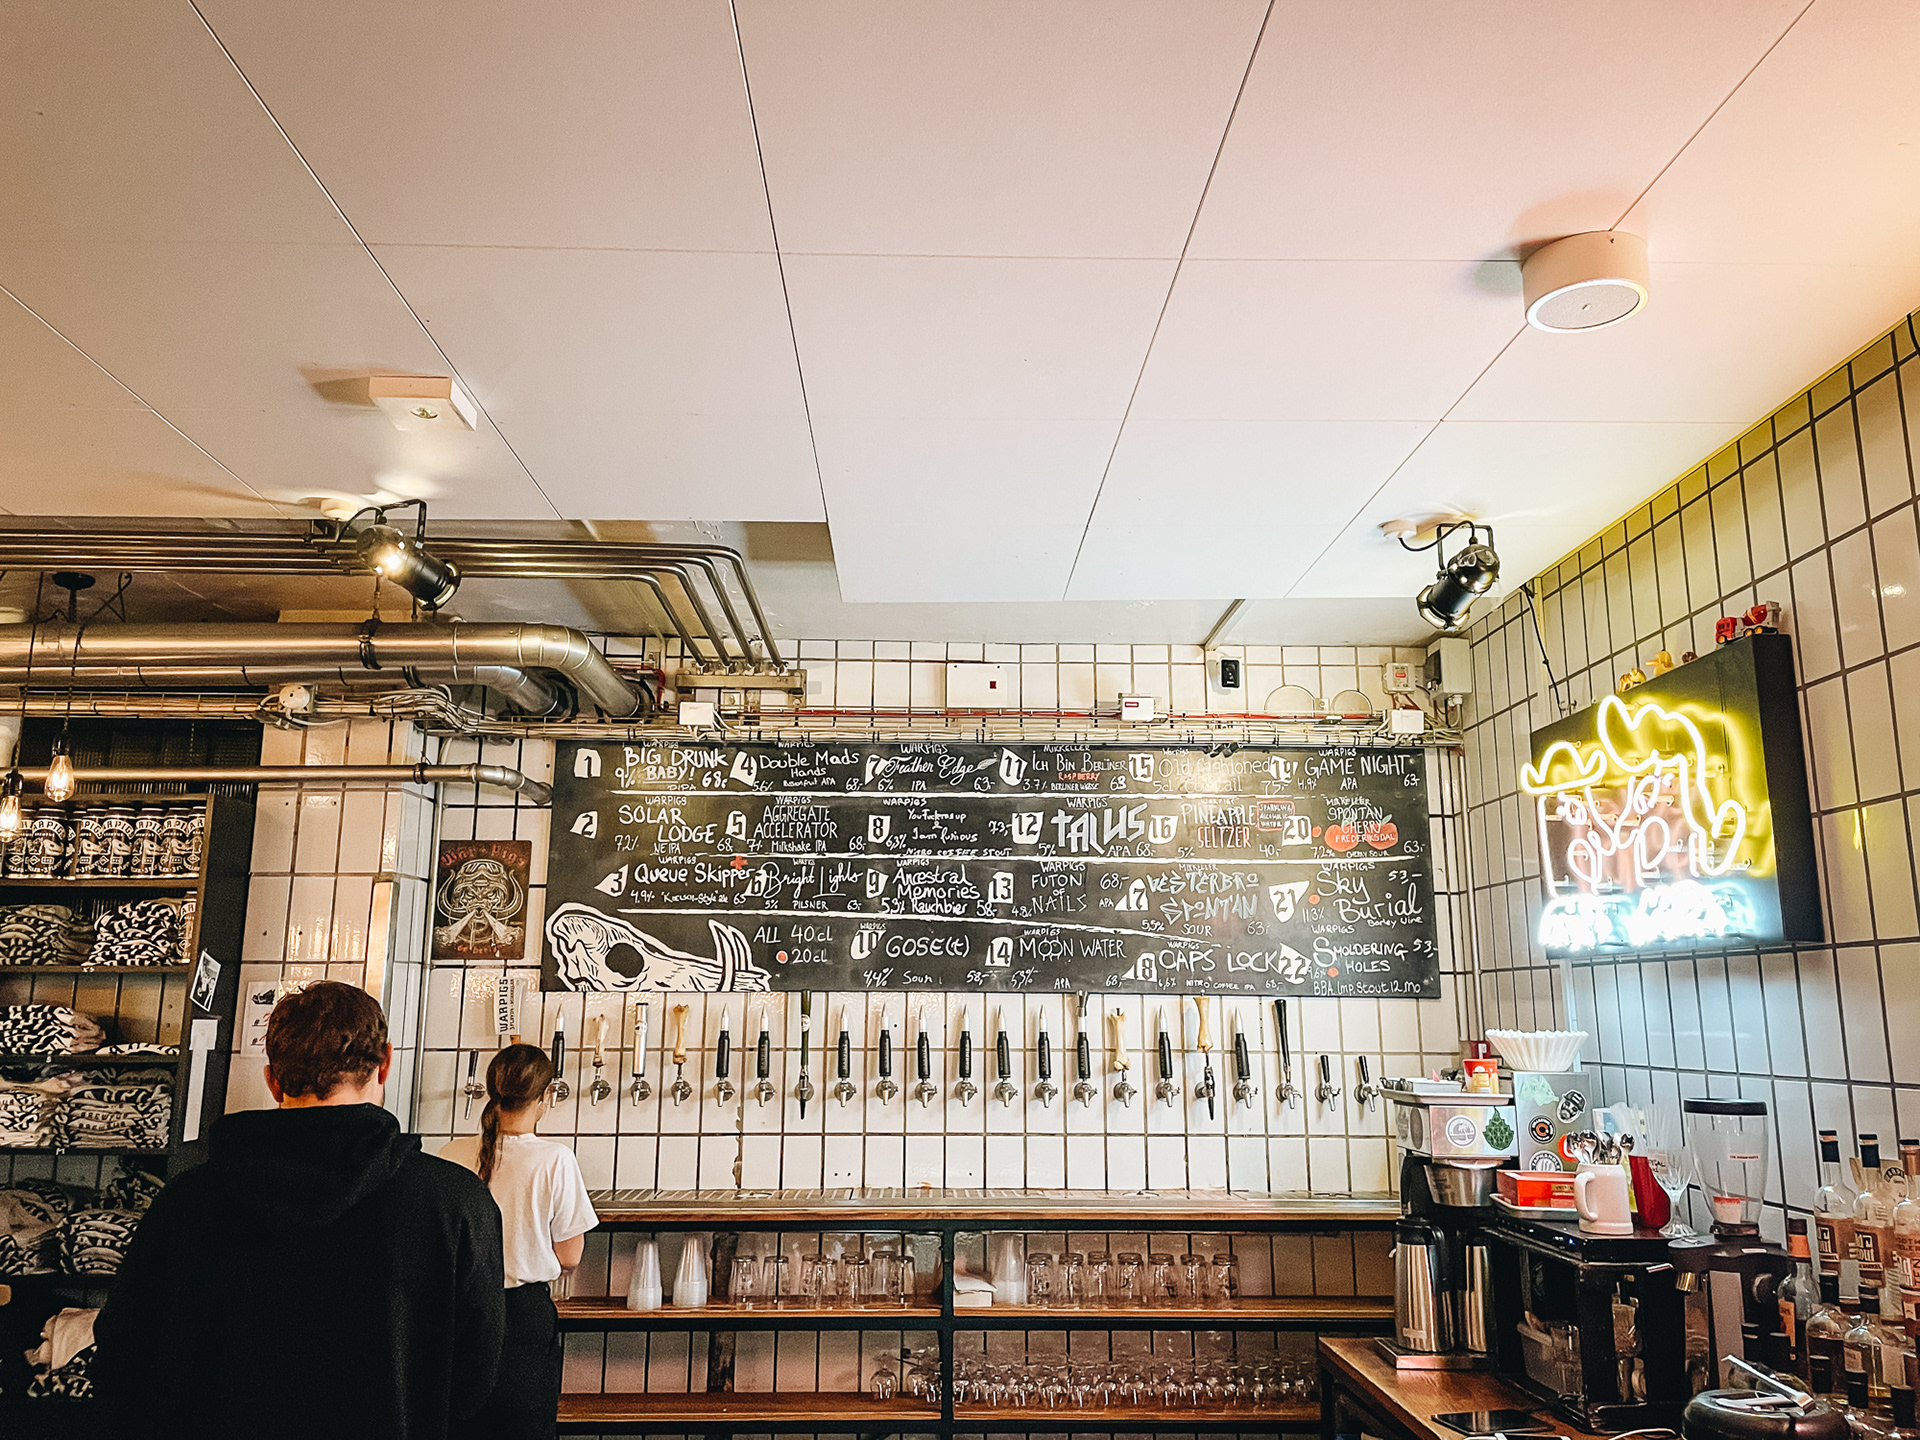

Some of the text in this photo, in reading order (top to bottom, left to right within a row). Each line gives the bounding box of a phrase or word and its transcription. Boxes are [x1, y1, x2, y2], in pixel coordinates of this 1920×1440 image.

[900, 743, 949, 754] WARPIGS
[1318, 748, 1357, 757] WARPIGS
[624, 747, 729, 770] BIG DRUNK
[760, 753, 810, 768] Double
[1305, 755, 1410, 778] GAME NIGHT
[643, 765, 695, 781] BABY!
[791, 767, 826, 778] Hands
[937, 755, 978, 785] Edge
[1159, 758, 1190, 778] Old
[911, 780, 927, 791] IPA
[1340, 778, 1358, 790] APA
[645, 796, 688, 806] WARPIGS
[776, 797, 812, 805] WARPIGS
[883, 798, 927, 806] WARPIGS
[1066, 797, 1108, 808] WARPIGS
[618, 805, 686, 826] SOLAR
[763, 805, 831, 822] AGGREGATE
[1180, 803, 1257, 825] PINEAPPLE
[754, 821, 838, 839] ACCELERATOR
[1015, 813, 1037, 836] 12
[1050, 802, 1147, 854] TALUS
[1284, 817, 1309, 840] 20
[1341, 819, 1382, 834] CHERRY
[658, 824, 718, 844] LODGE
[1197, 826, 1252, 848] SELTZER
[1335, 834, 1396, 843] FREDERIKSDAL
[815, 840, 827, 852] IPA
[983, 848, 1012, 856] STOUT
[1107, 845, 1131, 858] APA
[658, 856, 697, 865] WARPIGS
[897, 858, 930, 867] WARPIGS
[1041, 861, 1086, 873] WARPIGS
[1321, 860, 1376, 871] WARPIGS
[634, 862, 750, 888] Queue Skipper
[760, 861, 815, 899] Bright
[892, 864, 973, 887] Ancestral
[1032, 873, 1082, 889] FUTON
[1147, 870, 1259, 895] VESTERBRO
[897, 884, 981, 900] Memories
[1317, 870, 1370, 905] Sky
[793, 900, 829, 910] PILSNER
[911, 898, 967, 915] Rauchbier
[1031, 893, 1088, 915] NAILS
[1099, 898, 1114, 908] APA
[1160, 893, 1259, 925] SPONTAN
[1333, 882, 1423, 924] Burial
[753, 926, 781, 944] ALL
[1023, 927, 1061, 937] WARPIGS
[1181, 923, 1213, 937] SOUR
[1311, 925, 1356, 934] WARPIGS
[1019, 936, 1127, 961] MOON WATER
[1167, 941, 1200, 949] WARPIGS
[1313, 937, 1409, 967] SMOLDERING
[1158, 949, 1279, 973] CAPS LOCK
[1345, 959, 1391, 974] HOLES
[1054, 978, 1071, 990] APA
[1356, 980, 1389, 994] Stout
[498, 979, 509, 1032] WARPIGS
